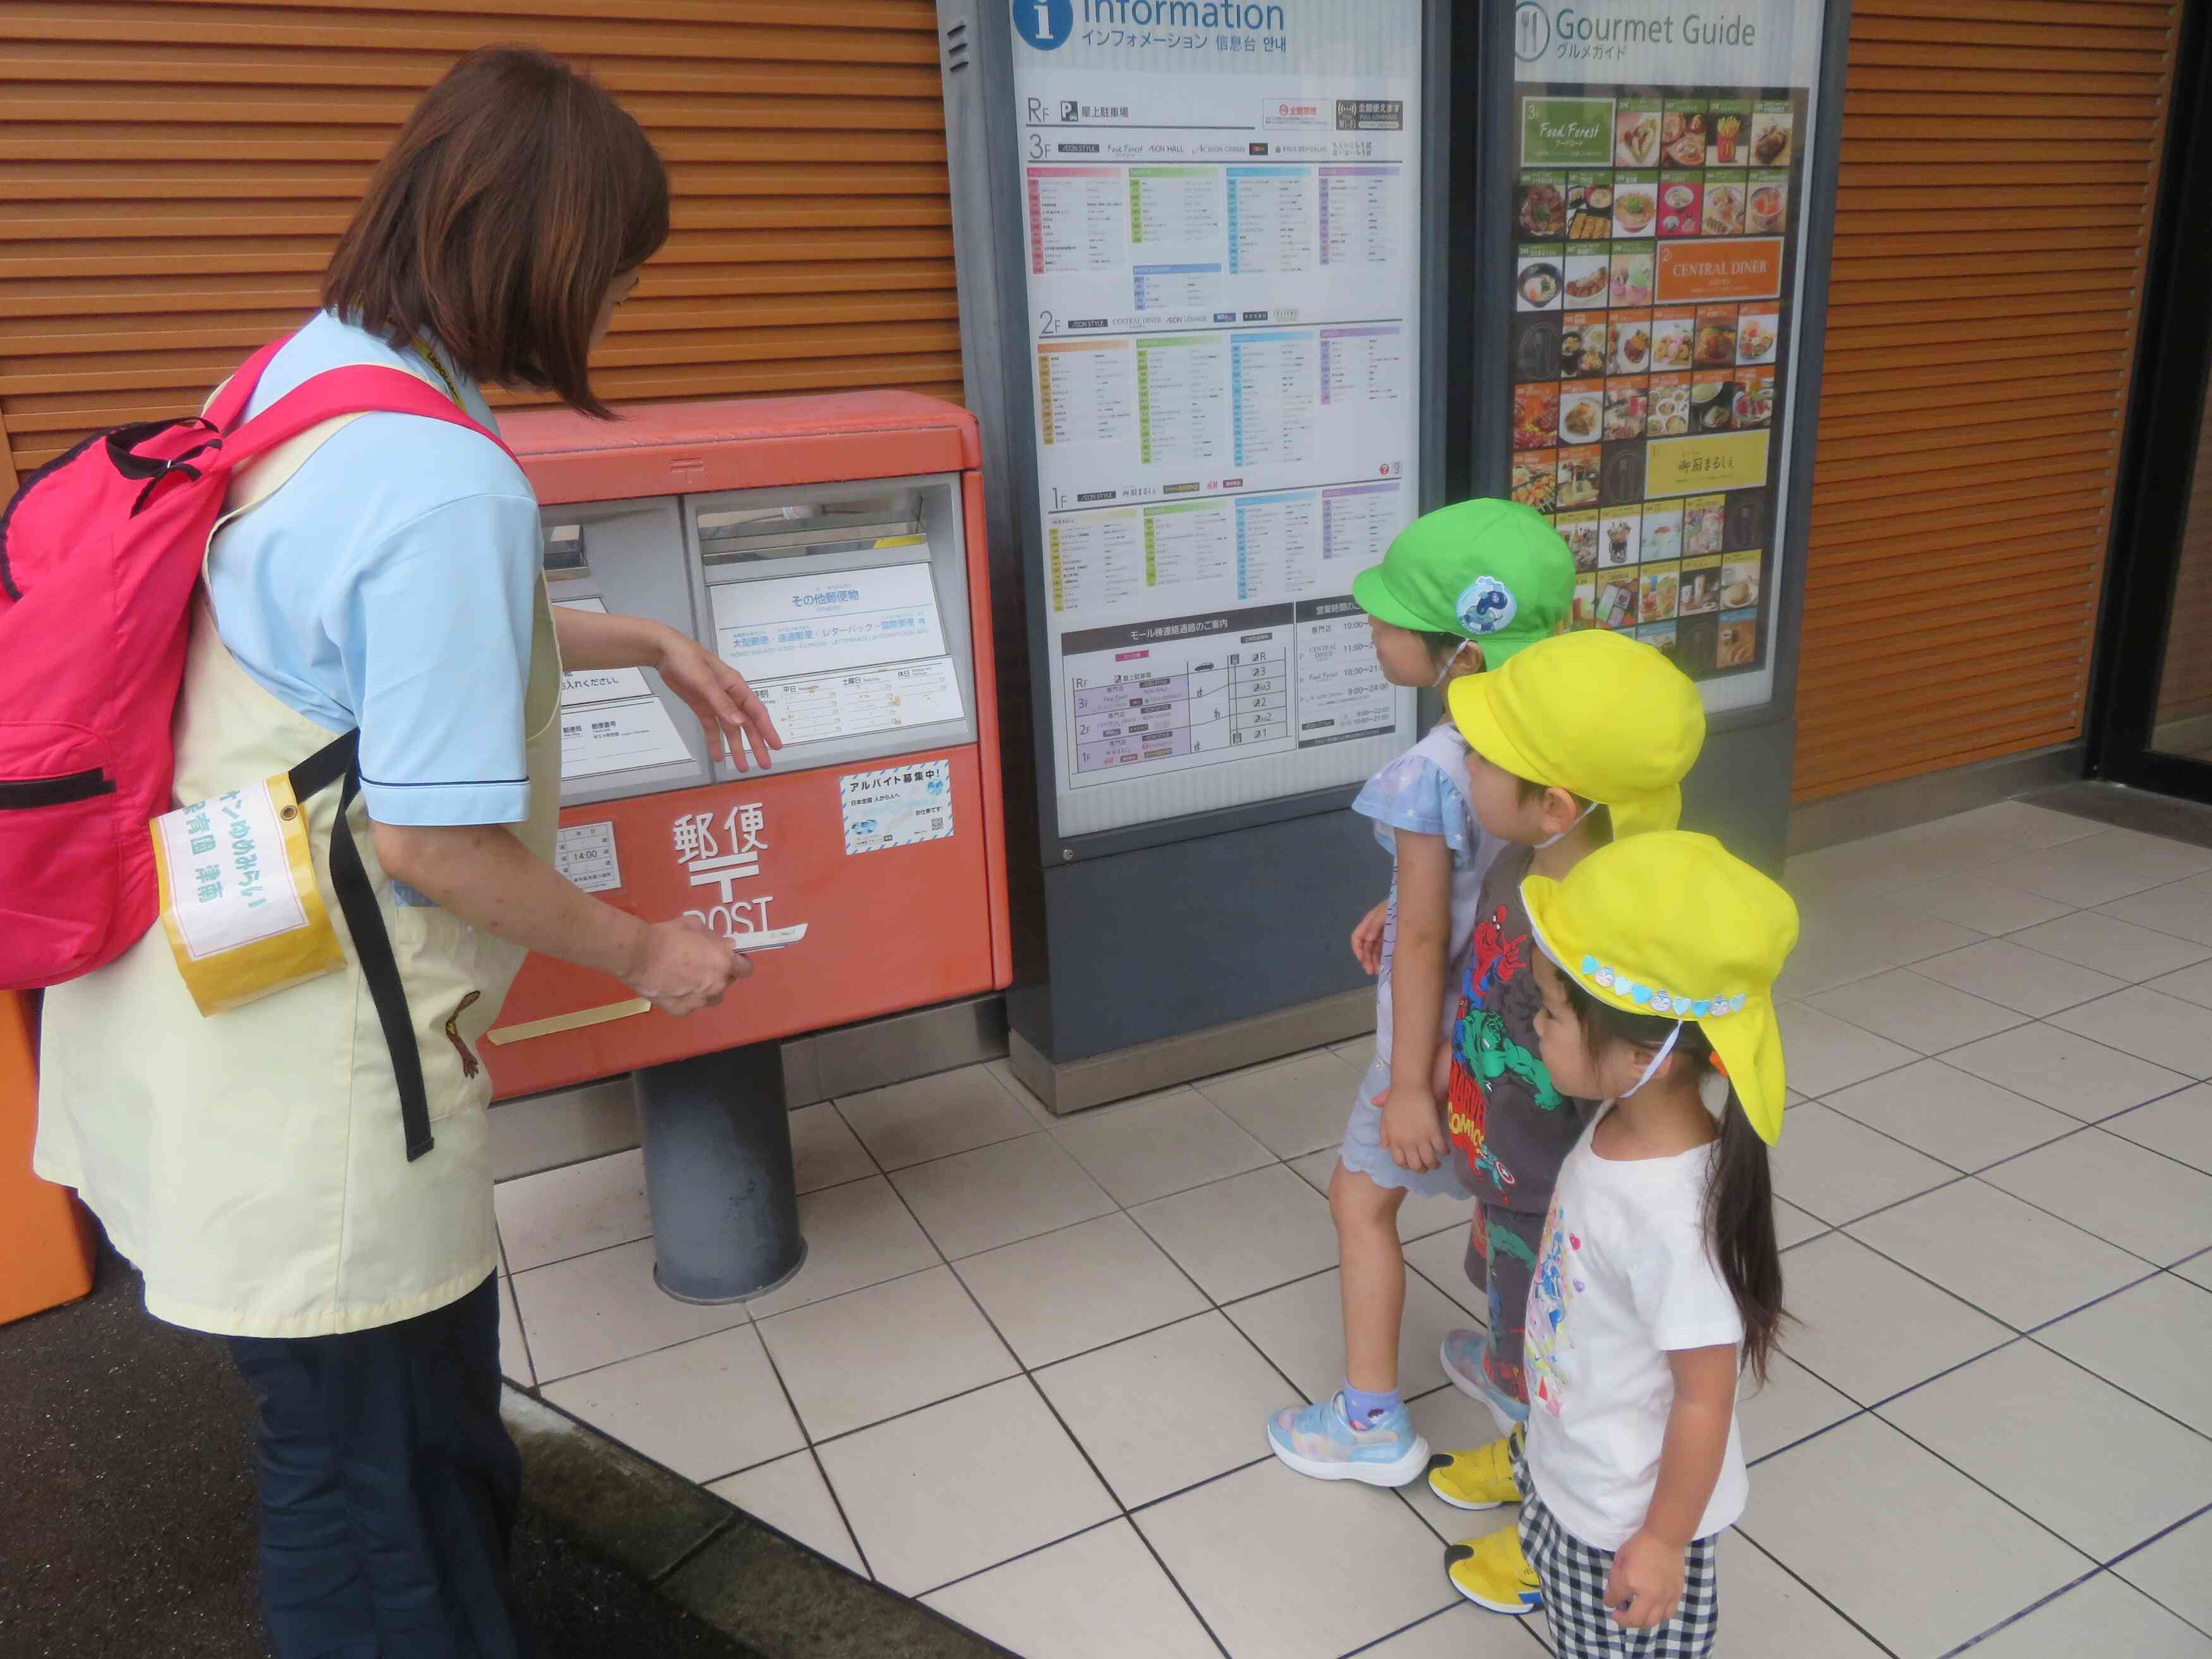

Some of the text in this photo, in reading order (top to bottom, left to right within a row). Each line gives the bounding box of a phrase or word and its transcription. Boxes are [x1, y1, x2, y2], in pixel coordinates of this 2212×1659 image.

[1083, 0, 1284, 30] Information
[1556, 8, 1756, 46] Gourmet Guide
[1082, 30, 1208, 49] インフォメーション
[1263, 35, 1287, 52] 안내
[1557, 44, 1627, 60] グルメガイド
[1673, 259, 1767, 277] CENTRAL DINER
[791, 590, 860, 607] その他郵便物
[842, 676, 861, 686] 土曜日
[897, 670, 910, 678] 休日
[783, 685, 796, 693] 平日
[673, 802, 768, 864] 郵便
